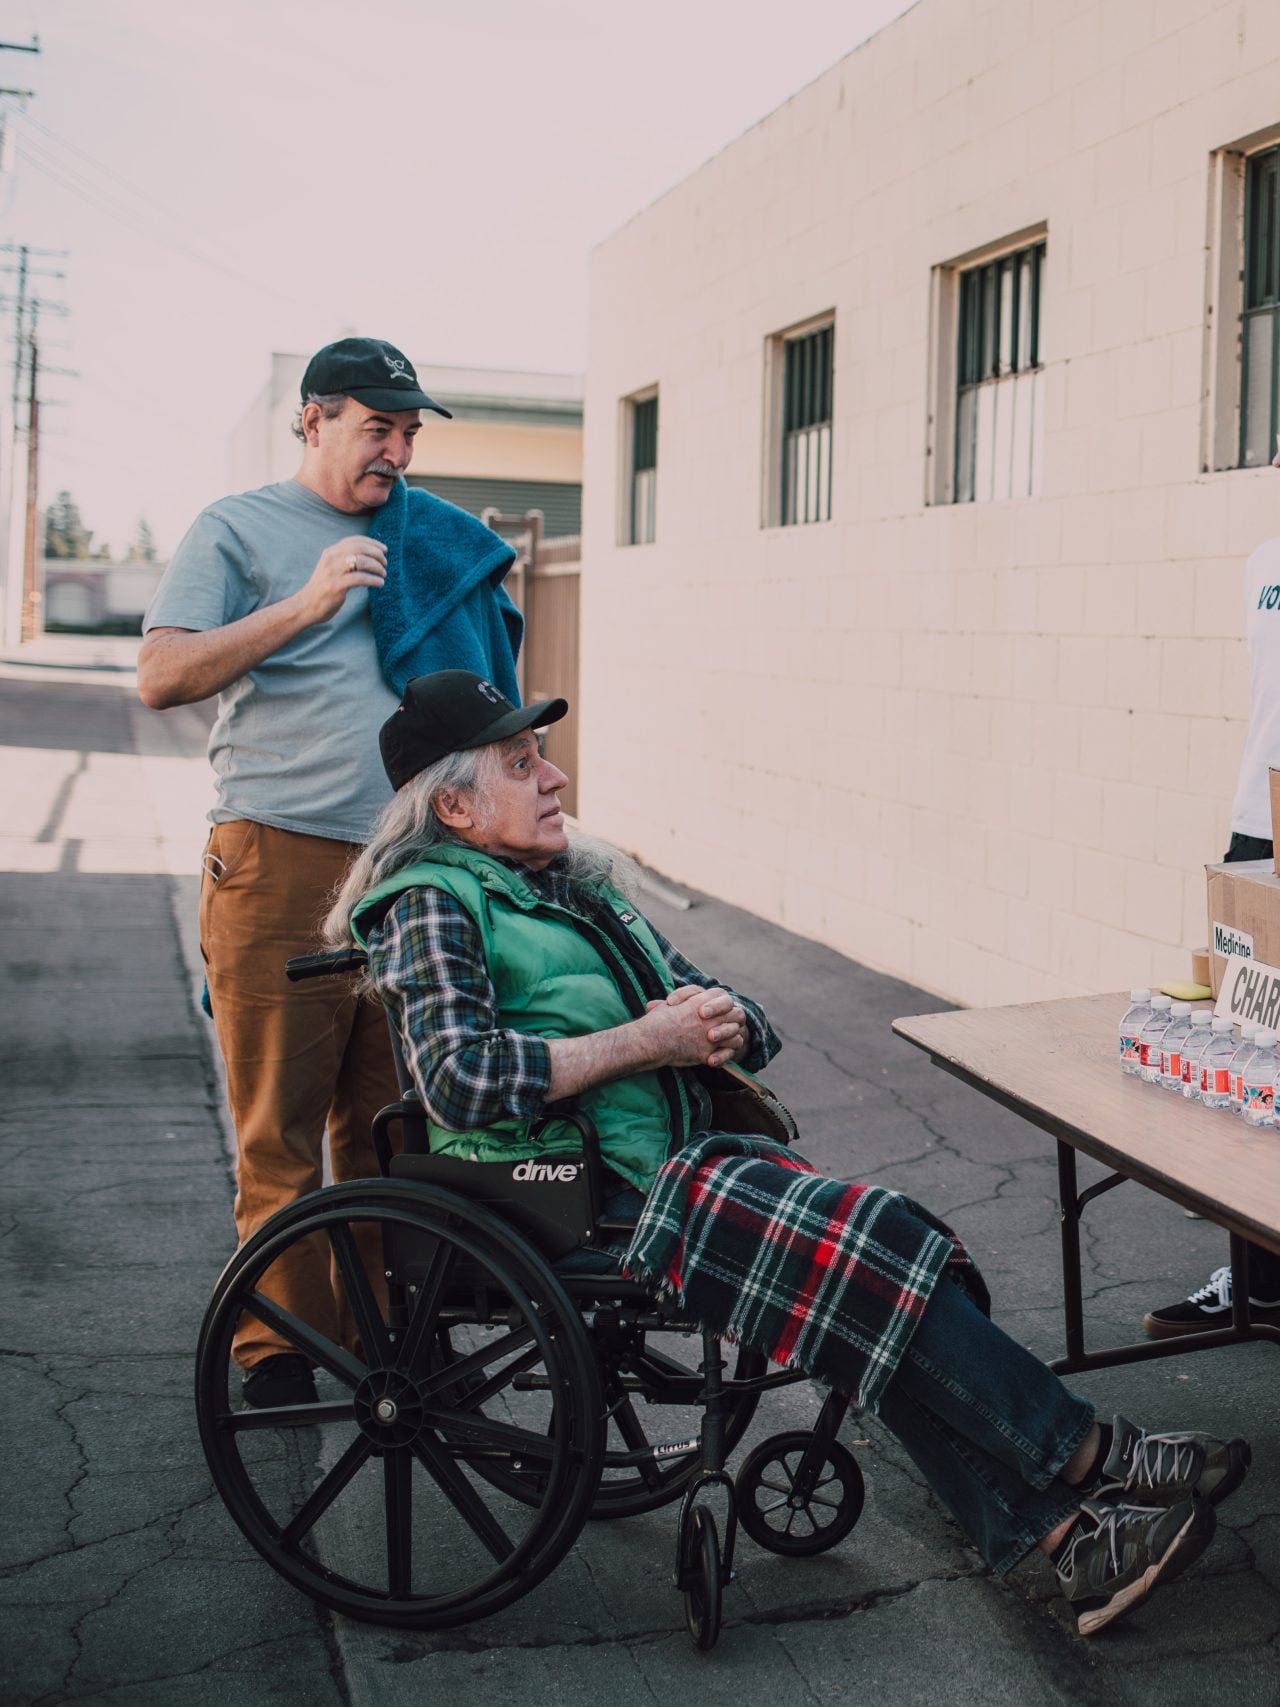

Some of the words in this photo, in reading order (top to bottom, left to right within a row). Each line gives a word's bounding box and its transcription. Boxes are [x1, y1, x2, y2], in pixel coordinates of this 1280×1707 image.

[1215, 926, 1251, 958] Medicine
[512, 1159, 578, 1182] drive
[657, 1441, 690, 1454] Cirrus
